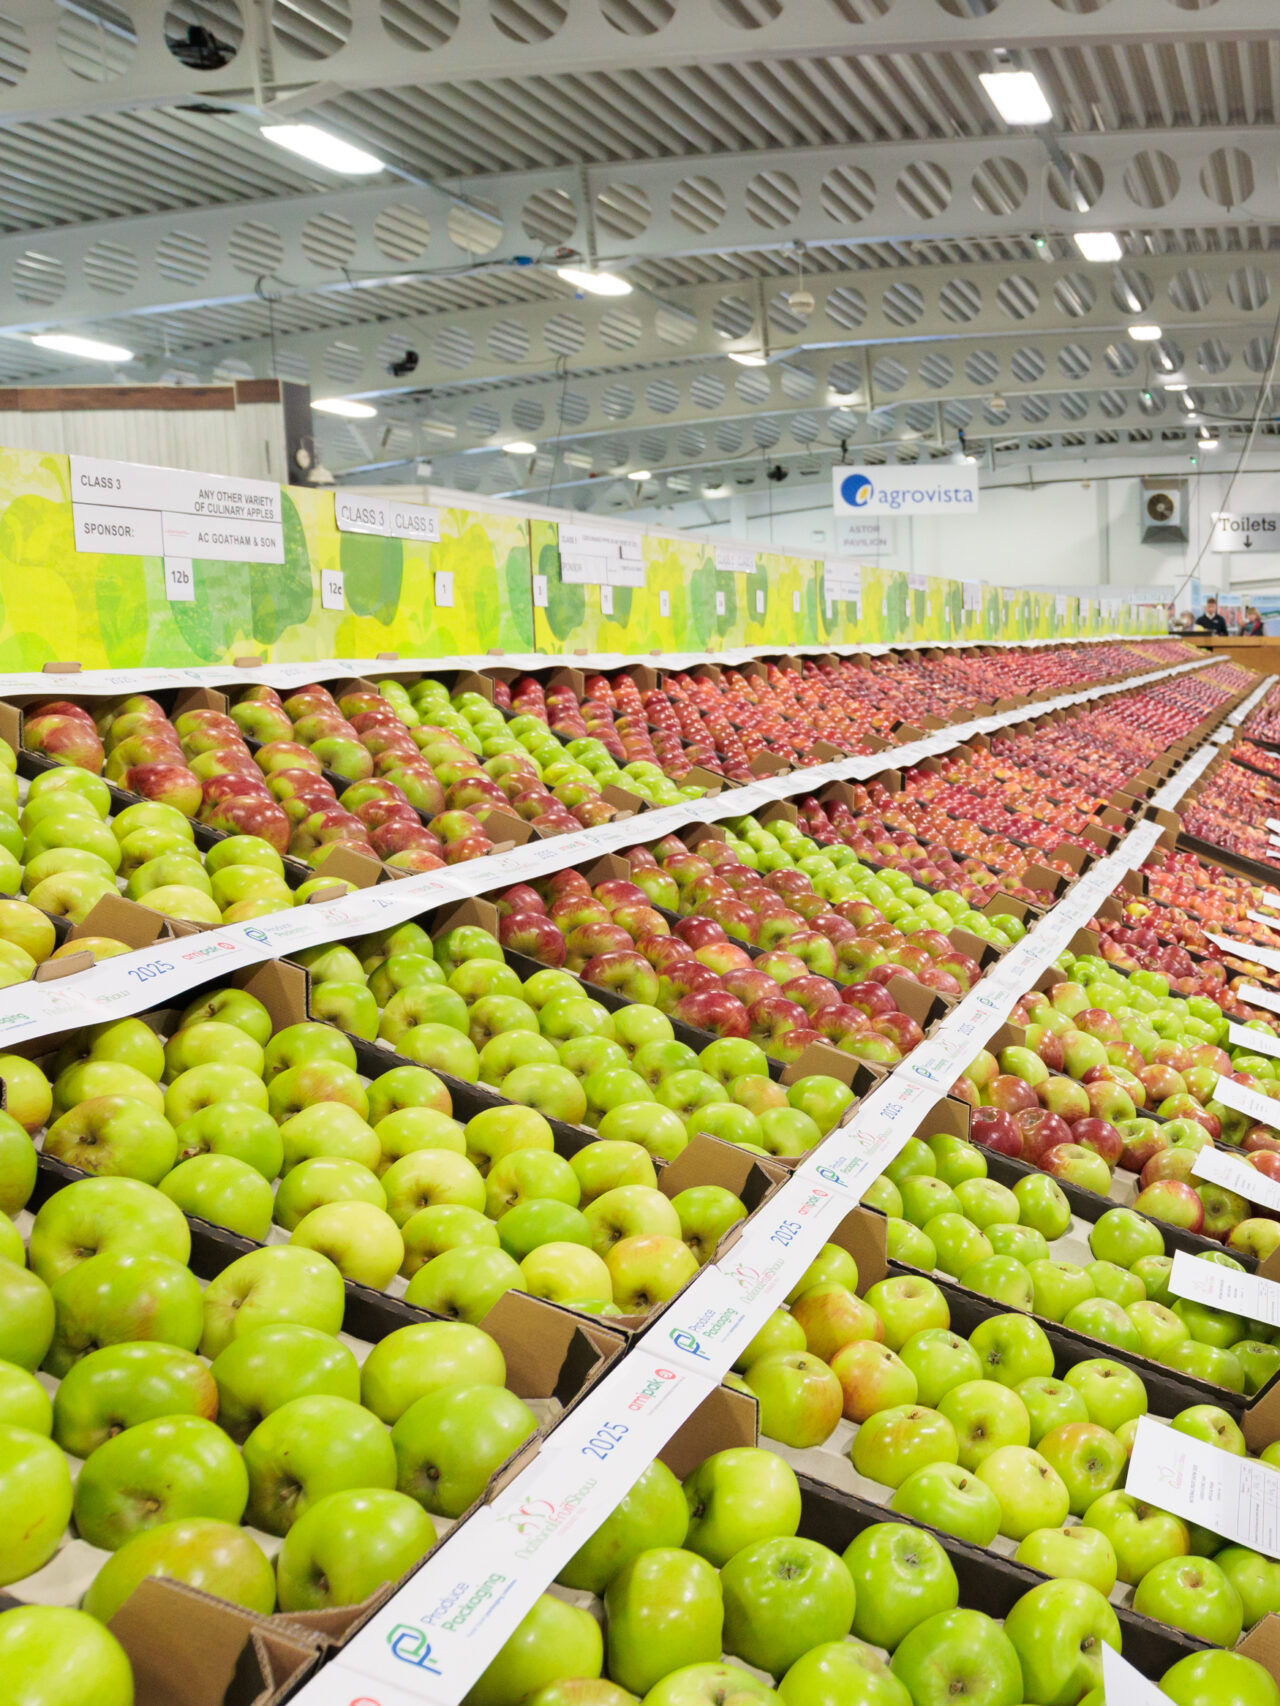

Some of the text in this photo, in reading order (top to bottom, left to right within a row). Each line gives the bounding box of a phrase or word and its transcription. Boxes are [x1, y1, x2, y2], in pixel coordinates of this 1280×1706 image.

[80, 475, 122, 490] CLASS 3
[199, 489, 274, 507] ANY OTHER VARIETY
[878, 485, 974, 509] agrovista
[194, 502, 274, 520] OF CULINARY APPLES
[341, 505, 385, 527] CLASS 3
[84, 523, 135, 538] SPONSOR:
[395, 513, 434, 533] CLASS 5
[849, 525, 880, 533] ASTOR
[1217, 517, 1277, 532] Toilets
[197, 532, 210, 543] AC
[212, 534, 251, 546] GOATHAM
[253, 537, 259, 547] &
[260, 537, 276, 548] SON
[843, 538, 887, 547] PAVILION
[171, 570, 190, 584] 12b
[127, 960, 175, 983] 2025
[770, 1220, 802, 1247] 2025
[688, 1309, 716, 1332] Produce
[703, 1307, 738, 1338] Packaging
[628, 1379, 665, 1412] amipak
[581, 1421, 629, 1461] 2025
[420, 1581, 470, 1626] Produce
[441, 1573, 506, 1632] Packaging
